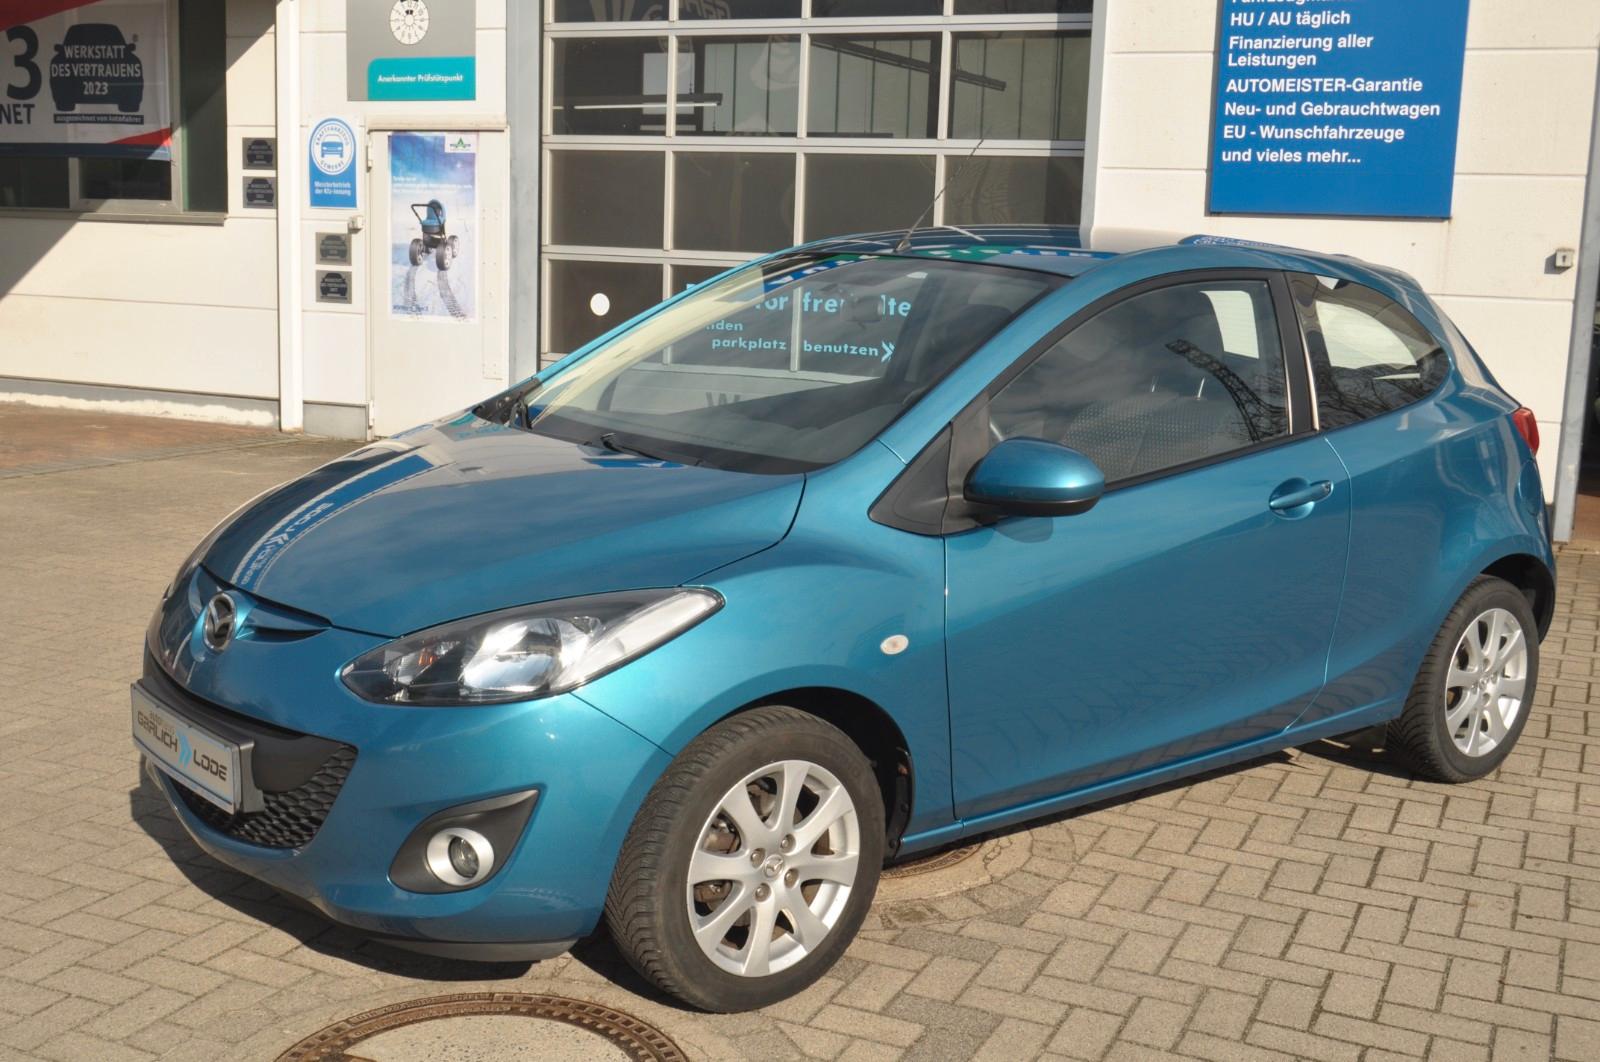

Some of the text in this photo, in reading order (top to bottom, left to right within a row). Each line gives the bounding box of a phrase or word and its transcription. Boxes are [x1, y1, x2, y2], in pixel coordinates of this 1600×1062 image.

[1230, 11, 1350, 28] HU / AU täglich
[1229, 34, 1374, 51] Finanzierung aller
[64, 45, 126, 59] WERKSTATT
[6, 25, 42, 100] 3
[1228, 53, 1317, 69] Leistungen
[51, 64, 141, 77] DES VERTRAUENS
[83, 82, 109, 95] 2023
[1226, 77, 1423, 93] AUTOMEISTER-Garantie
[1225, 101, 1440, 119] Neu- und Gebrauchtwagen
[1223, 126, 1246, 138] EU
[1260, 125, 1405, 143] Wunschfahrzeuge
[1222, 148, 1361, 162] und vieles mehr...
[712, 337, 879, 357] parkplatz benutzen
